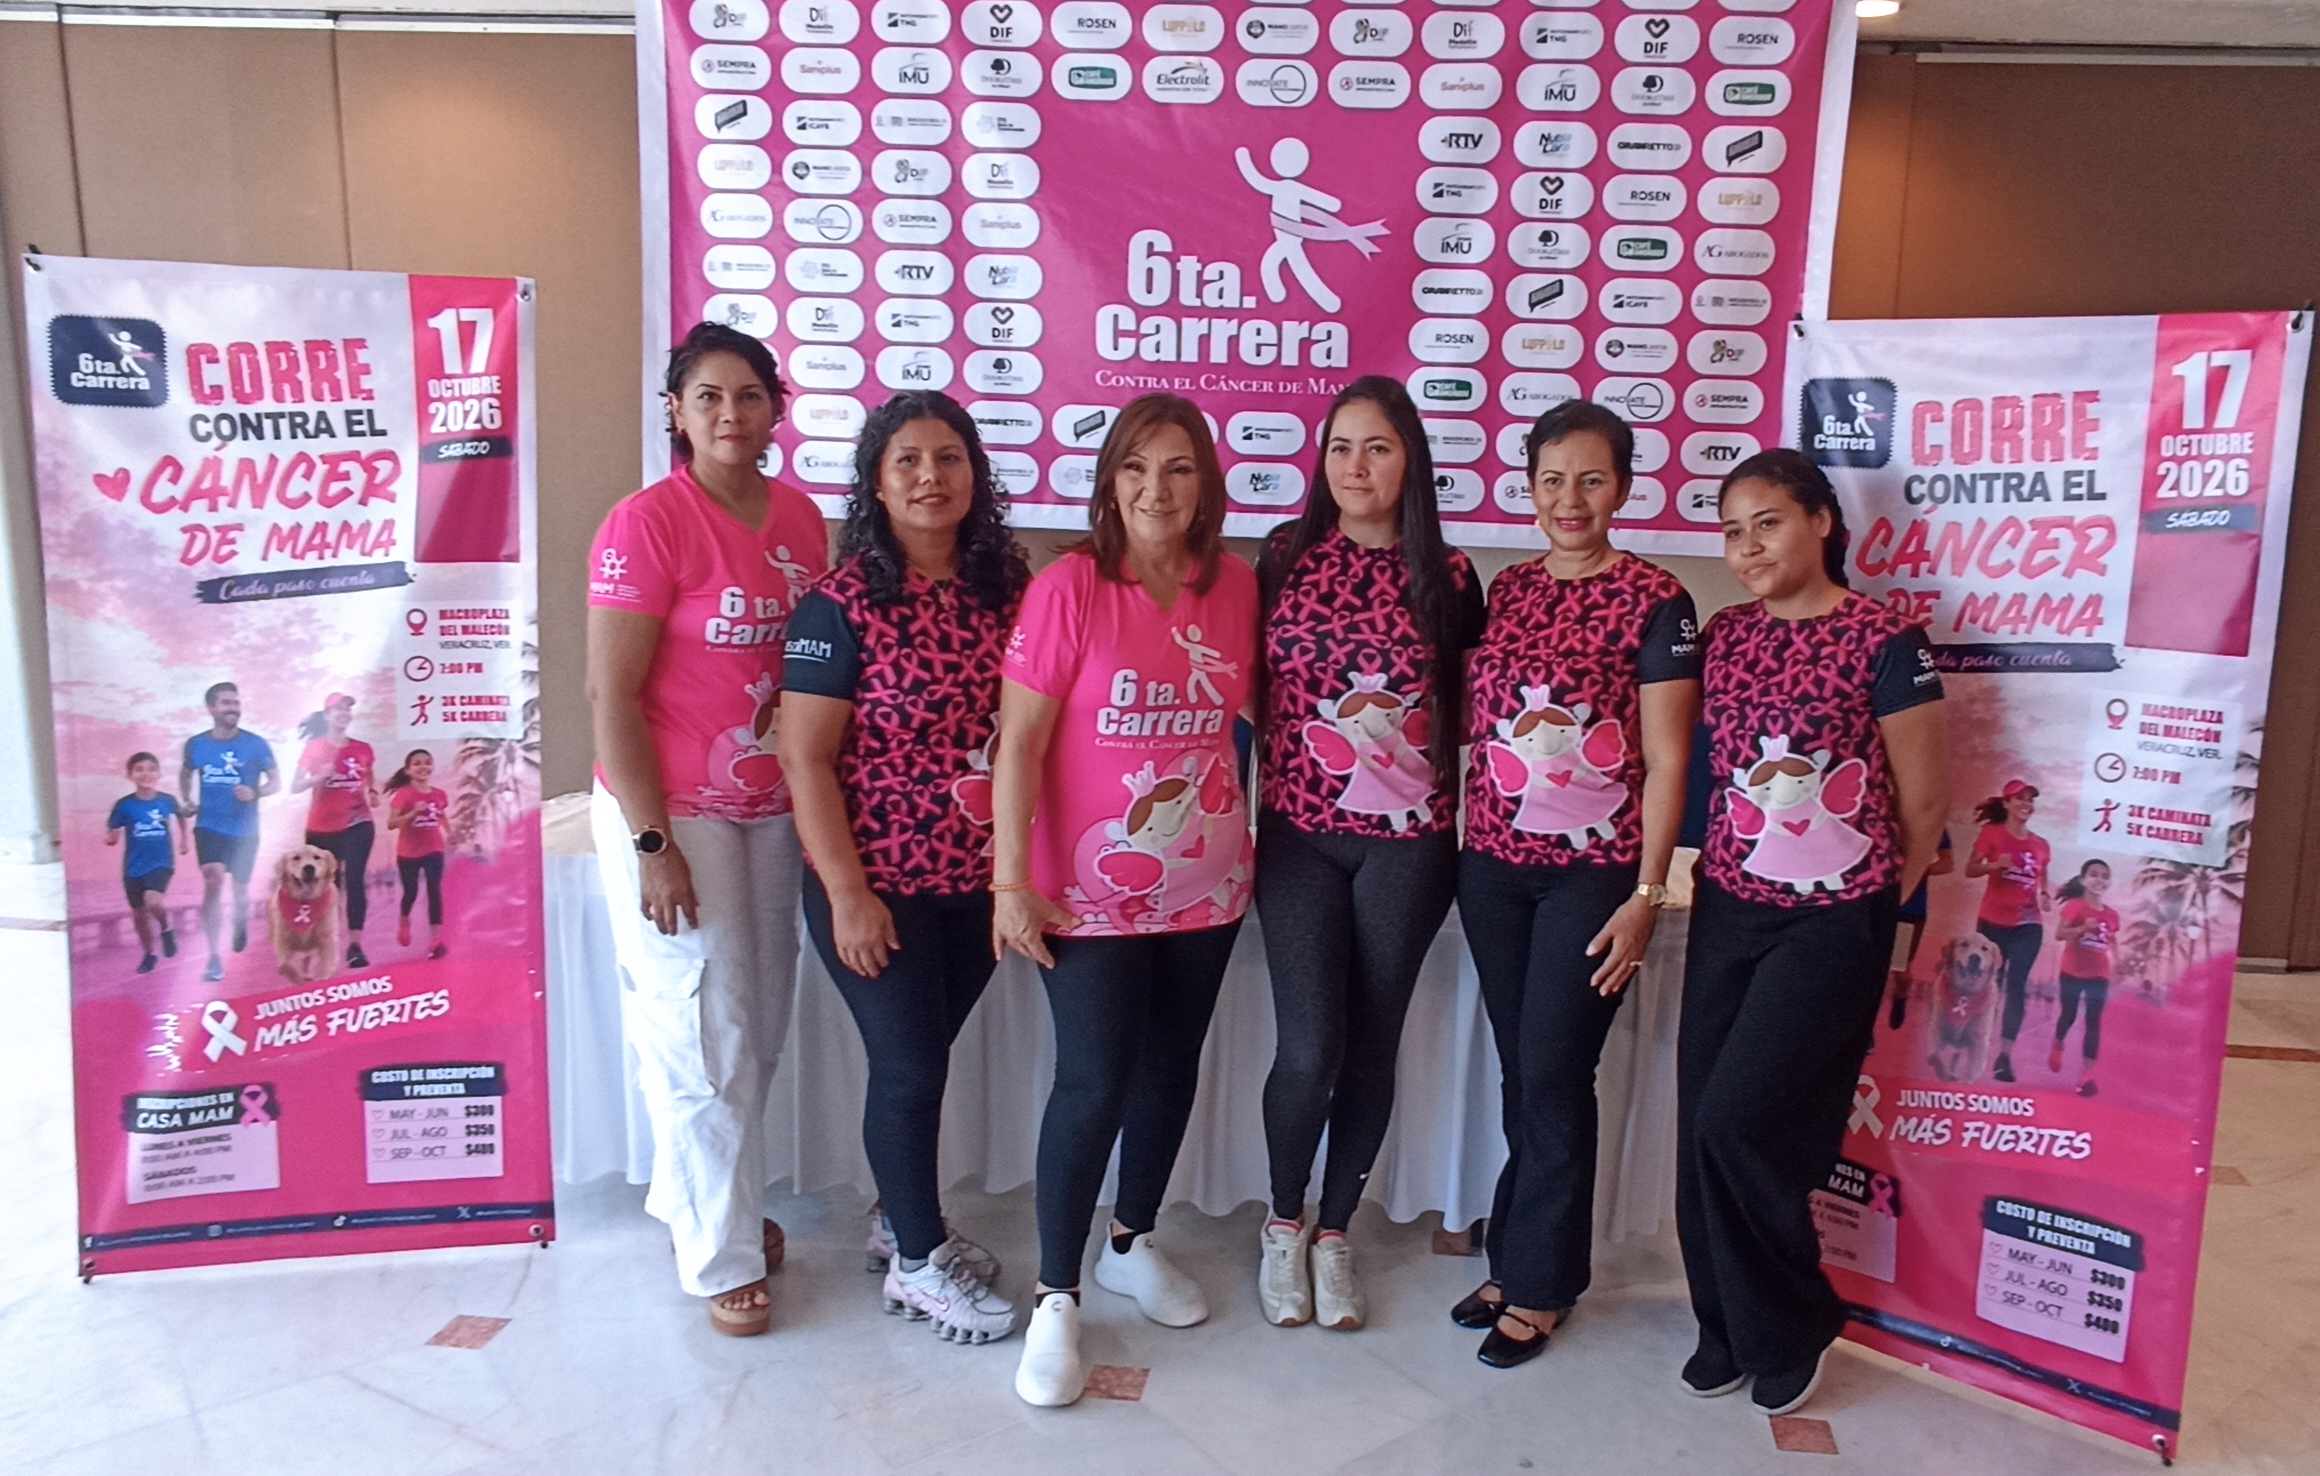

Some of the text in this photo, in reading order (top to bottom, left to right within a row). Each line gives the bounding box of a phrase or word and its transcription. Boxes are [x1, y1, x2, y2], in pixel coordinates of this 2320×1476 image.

[990, 26, 1013, 38] DIF
[1077, 18, 1116, 29] ROSEN
[1643, 42, 1669, 54] DIF
[1737, 33, 1779, 44] ROSEN
[717, 60, 757, 69] SEMPRA
[800, 64, 842, 75] Saniplus
[899, 70, 929, 84] IMU
[1157, 73, 1210, 86] Electrolit
[1355, 77, 1396, 86] SEMPRA
[1441, 82, 1485, 92] Saniplus
[1544, 88, 1576, 101] IMU
[1445, 189, 1462, 197] TNG
[1538, 198, 1563, 210] DIF
[1630, 190, 1671, 201] ROSEN
[898, 214, 938, 223] SEMPRA
[1440, 241, 1472, 254] IMU
[1126, 228, 1257, 309] 6ta.
[427, 307, 495, 375] 17
[991, 327, 1014, 339] DIF
[1095, 303, 1350, 368] Carrera
[1435, 333, 1474, 344] ROSEN
[79, 353, 121, 374] 6ta.
[186, 339, 376, 406] CORRE
[902, 367, 931, 381] IMU
[70, 372, 151, 390] Carrera
[427, 374, 502, 400] OCTUBRE
[2172, 350, 2253, 430] 17
[1711, 395, 1749, 404] SEMPRA
[190, 408, 388, 443] CONTRA EL
[428, 397, 503, 435] 2026
[1822, 414, 1855, 437] 6ta.
[1911, 390, 2100, 467] CORRE
[1814, 433, 1876, 452] Carrera
[2160, 432, 2254, 457] OCTUBRE
[139, 442, 402, 516] CÁNCER
[1904, 469, 2107, 506] CONTRA EL
[2157, 460, 2250, 500] 2026
[179, 518, 398, 567] DE MAMA
[1855, 503, 2117, 580] CÁNCER
[219, 571, 267, 600] Cada
[320, 569, 376, 591] cuenta
[720, 586, 786, 619] 6 ta.
[1884, 588, 2103, 637] DE MAMA
[2008, 649, 2072, 668] cuenta
[1110, 669, 1181, 706] 6 ta.
[1097, 707, 1224, 736] Carrera
[254, 975, 393, 1020] JUNTOS SOMOS
[254, 989, 450, 1052] MÁS FUERTES
[389, 1108, 449, 1120] MAY JUN
[1896, 1090, 2035, 1117] JUNTOS SOMOS
[136, 1105, 234, 1129] CASA MAM
[391, 1126, 448, 1140] JUL AGO
[1889, 1113, 2092, 1160] MÁS FUERTES
[391, 1145, 447, 1160] SEP OCT
[1828, 1174, 1865, 1198] MAM
[1996, 1200, 2036, 1221] COSTO
[2036, 1210, 2053, 1226] DE
[2027, 1225, 2096, 1255] Y PREVENTA
[2008, 1248, 2074, 1275] MAY JUN
[2005, 1270, 2068, 1297] JUL AGO
[2002, 1290, 2064, 1318] SEP OCT
[2087, 1290, 2123, 1312] $350
